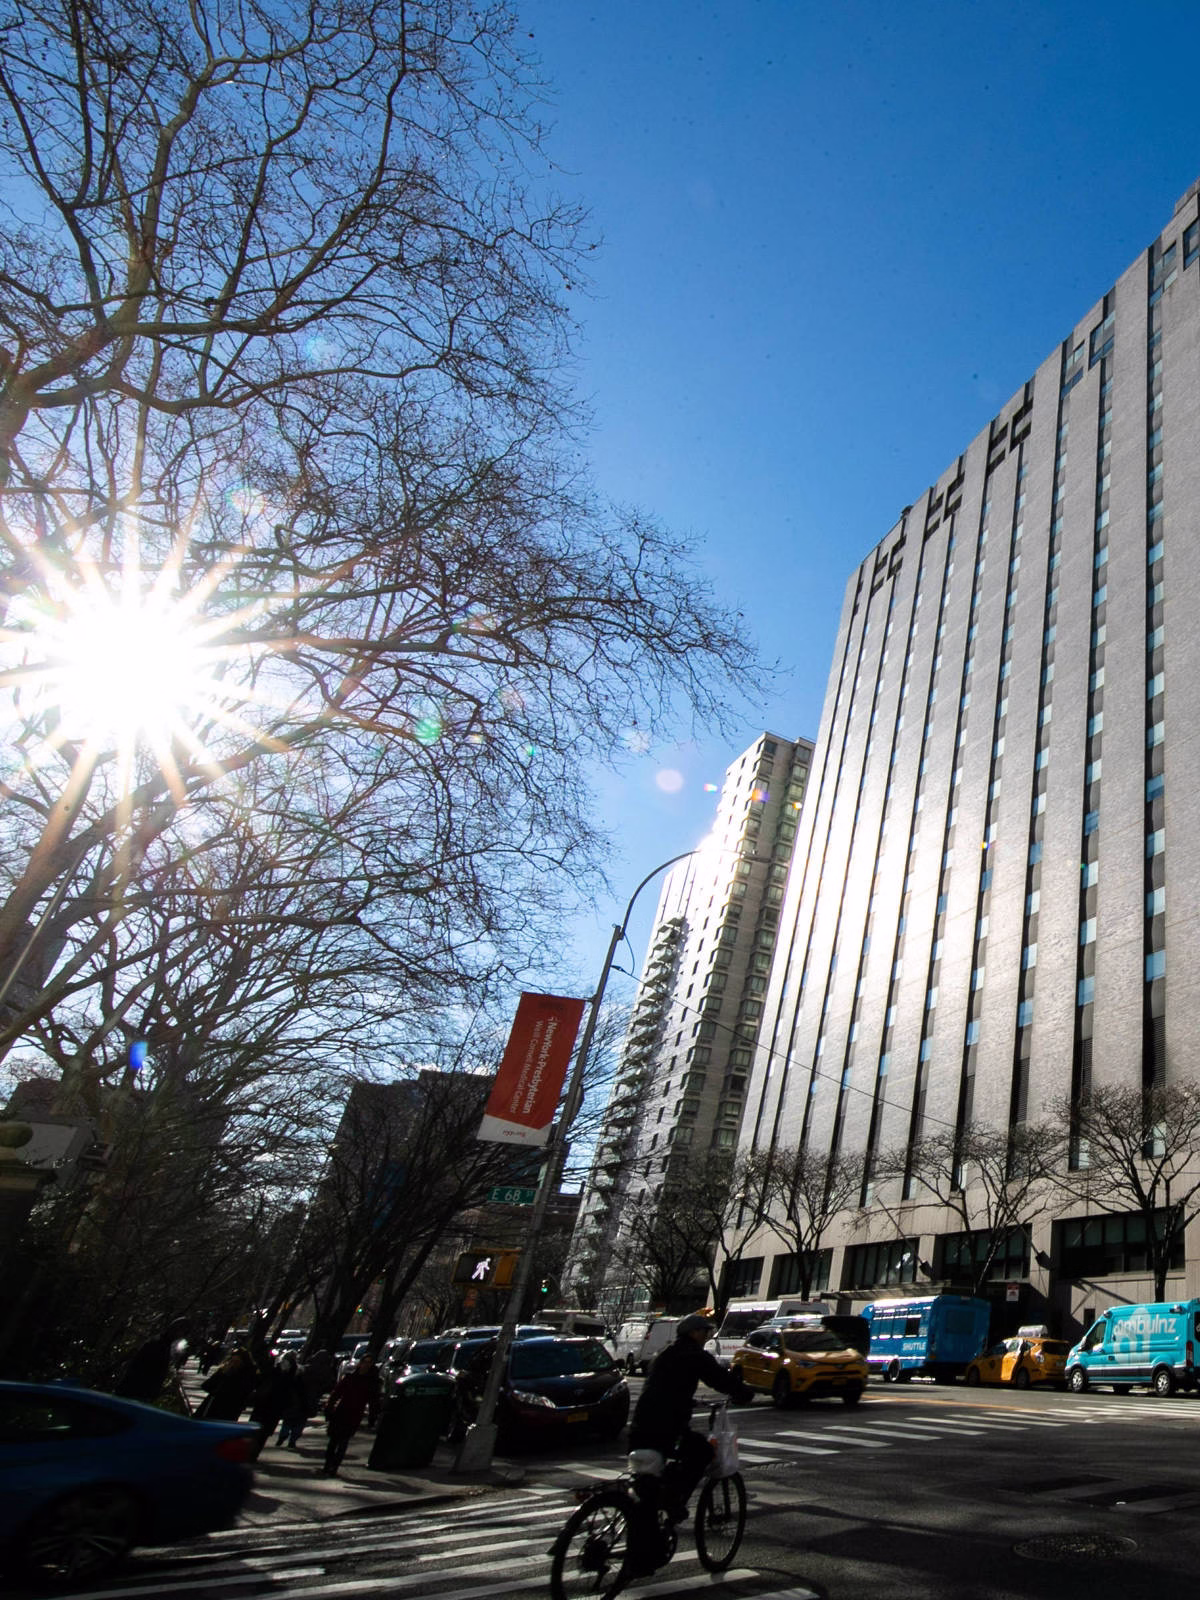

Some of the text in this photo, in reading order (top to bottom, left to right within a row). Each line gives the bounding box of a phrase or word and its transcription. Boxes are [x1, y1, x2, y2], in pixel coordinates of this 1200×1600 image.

[491, 1188, 500, 1201] E
[504, 1189, 520, 1201] 68
[1113, 1313, 1177, 1335] ambulnz
[902, 1342, 927, 1351] SHUTTLE
